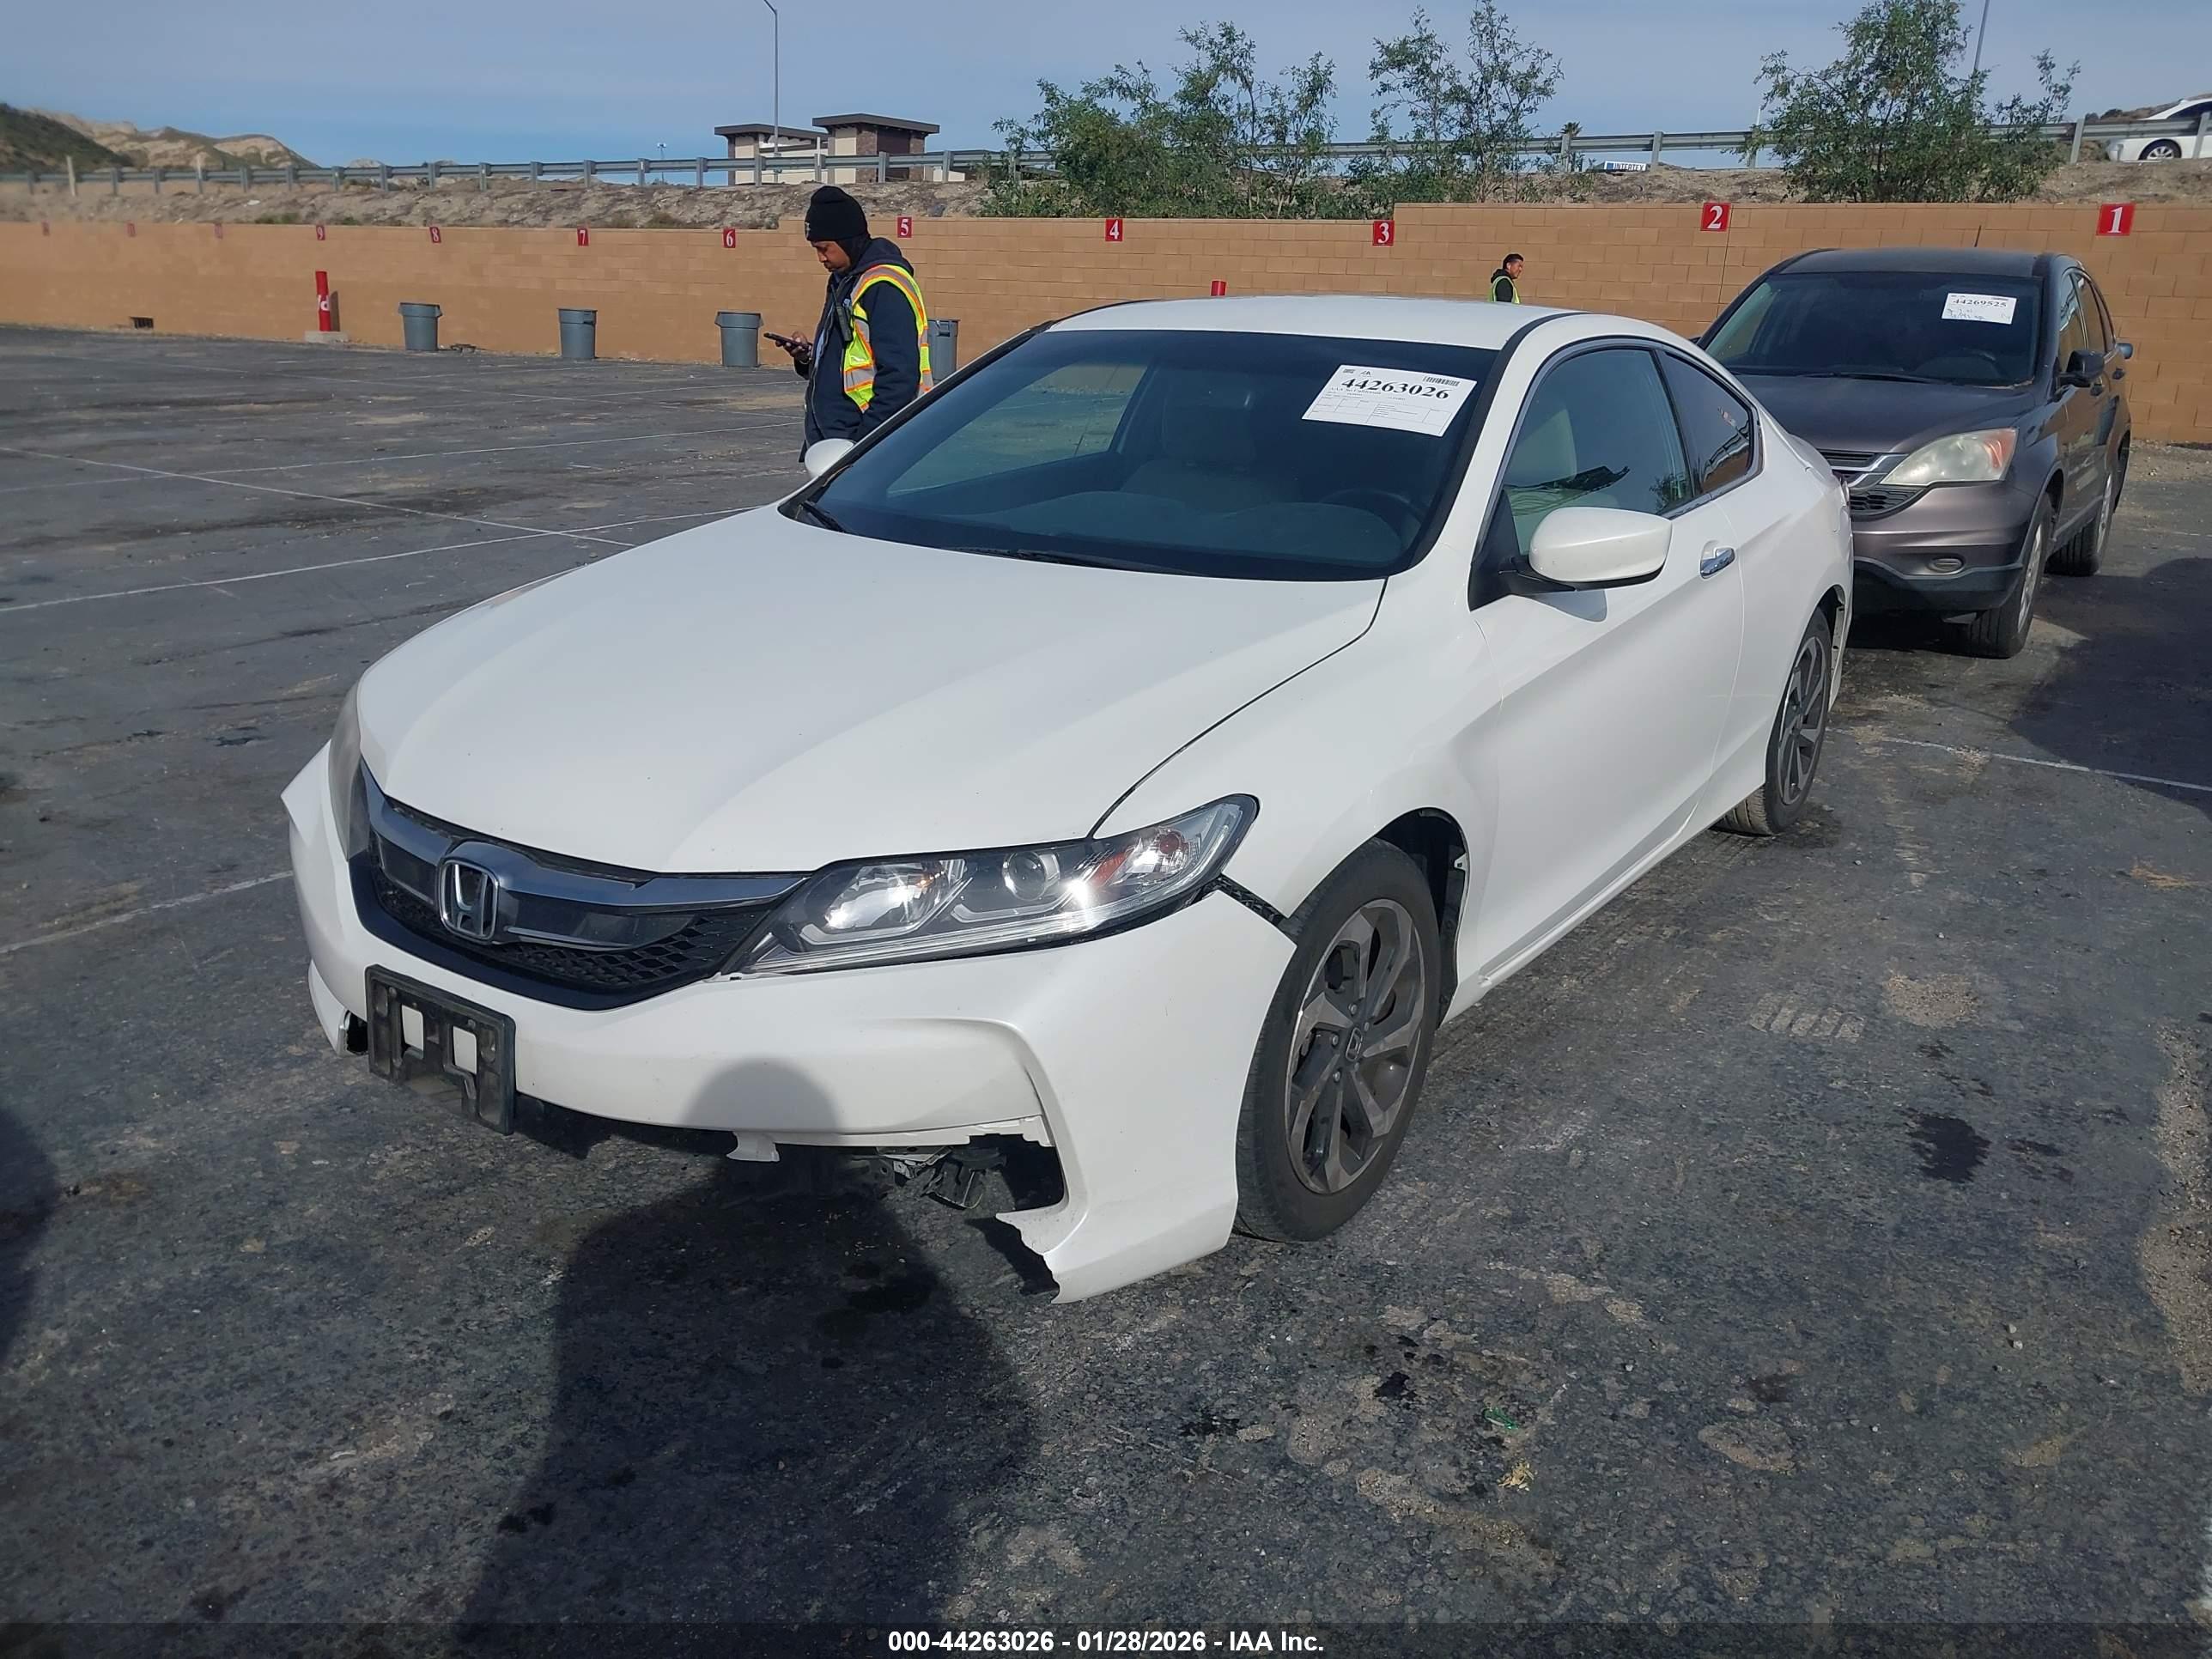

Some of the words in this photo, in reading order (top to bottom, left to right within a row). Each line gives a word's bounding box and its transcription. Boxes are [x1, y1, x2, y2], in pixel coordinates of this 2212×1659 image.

[1707, 205, 1723, 229] 2
[2108, 206, 2124, 234] 1
[318, 226, 324, 240] 9
[432, 228, 440, 243] 8
[901, 218, 909, 236] 5
[1109, 219, 1120, 240] 4
[1377, 222, 1389, 244] 3
[580, 229, 586, 245] 7
[726, 230, 734, 246] 6
[1952, 298, 2008, 307] 44269525
[1341, 378, 1453, 399] 44263026
